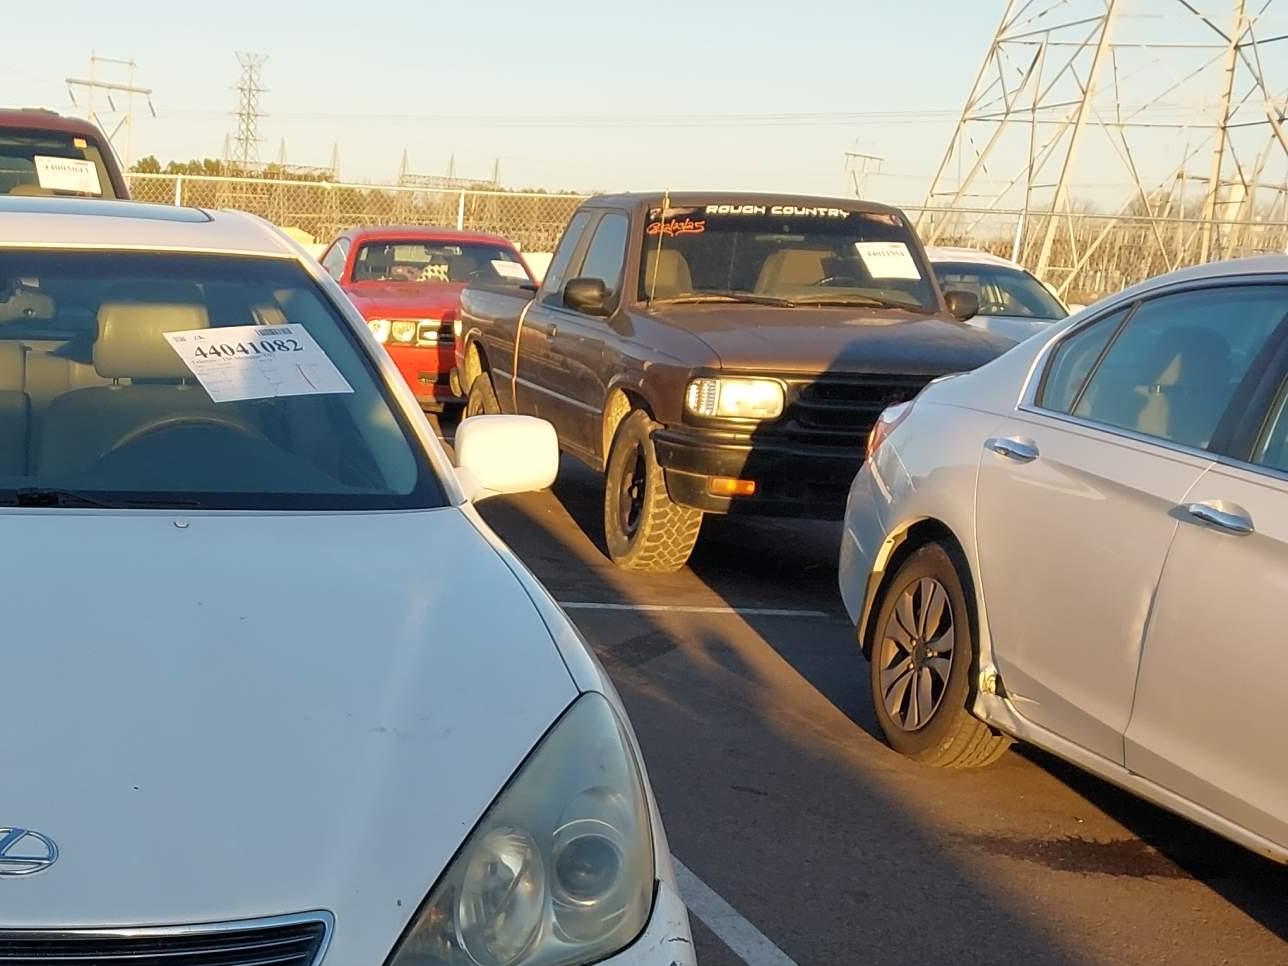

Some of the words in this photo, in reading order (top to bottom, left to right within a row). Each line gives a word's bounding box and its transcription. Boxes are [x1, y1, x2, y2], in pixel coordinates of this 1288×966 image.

[705, 204, 766, 215] ROUGH
[770, 206, 851, 219] COUNTRY
[194, 338, 304, 359] 44041082
